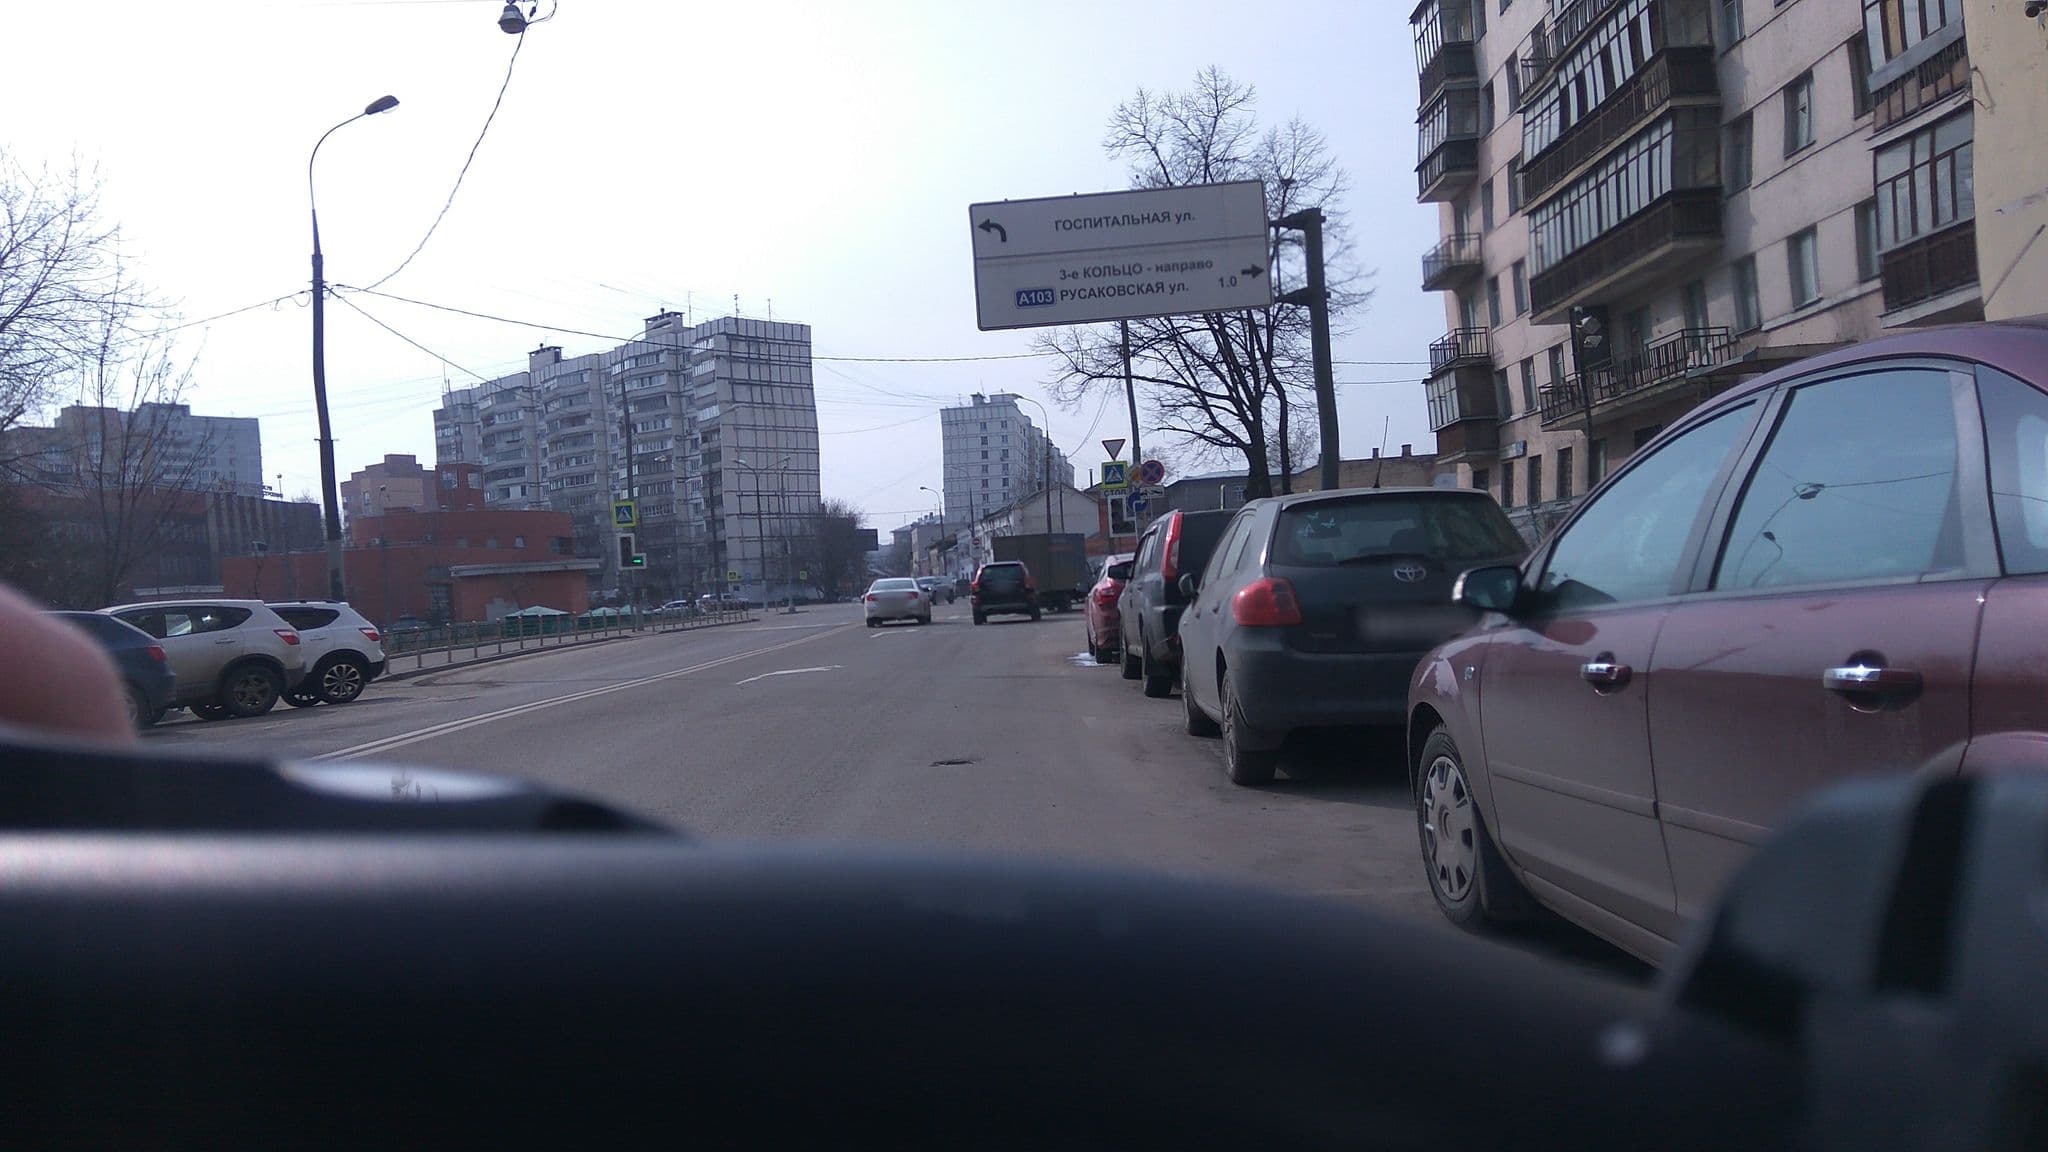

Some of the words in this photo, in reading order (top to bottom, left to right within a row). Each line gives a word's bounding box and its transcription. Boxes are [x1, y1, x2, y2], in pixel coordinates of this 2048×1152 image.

[1054, 210, 1171, 231] ГОСПИТАЛЬНАЯ
[1175, 212, 1195, 224] ул.
[1059, 269, 1079, 280] 3-е
[1083, 262, 1143, 278] КОЛЬЦО
[1218, 275, 1237, 288] 1.0
[1060, 282, 1165, 301] РУСАКОВСКАЯ
[1169, 282, 1189, 295] ул.
